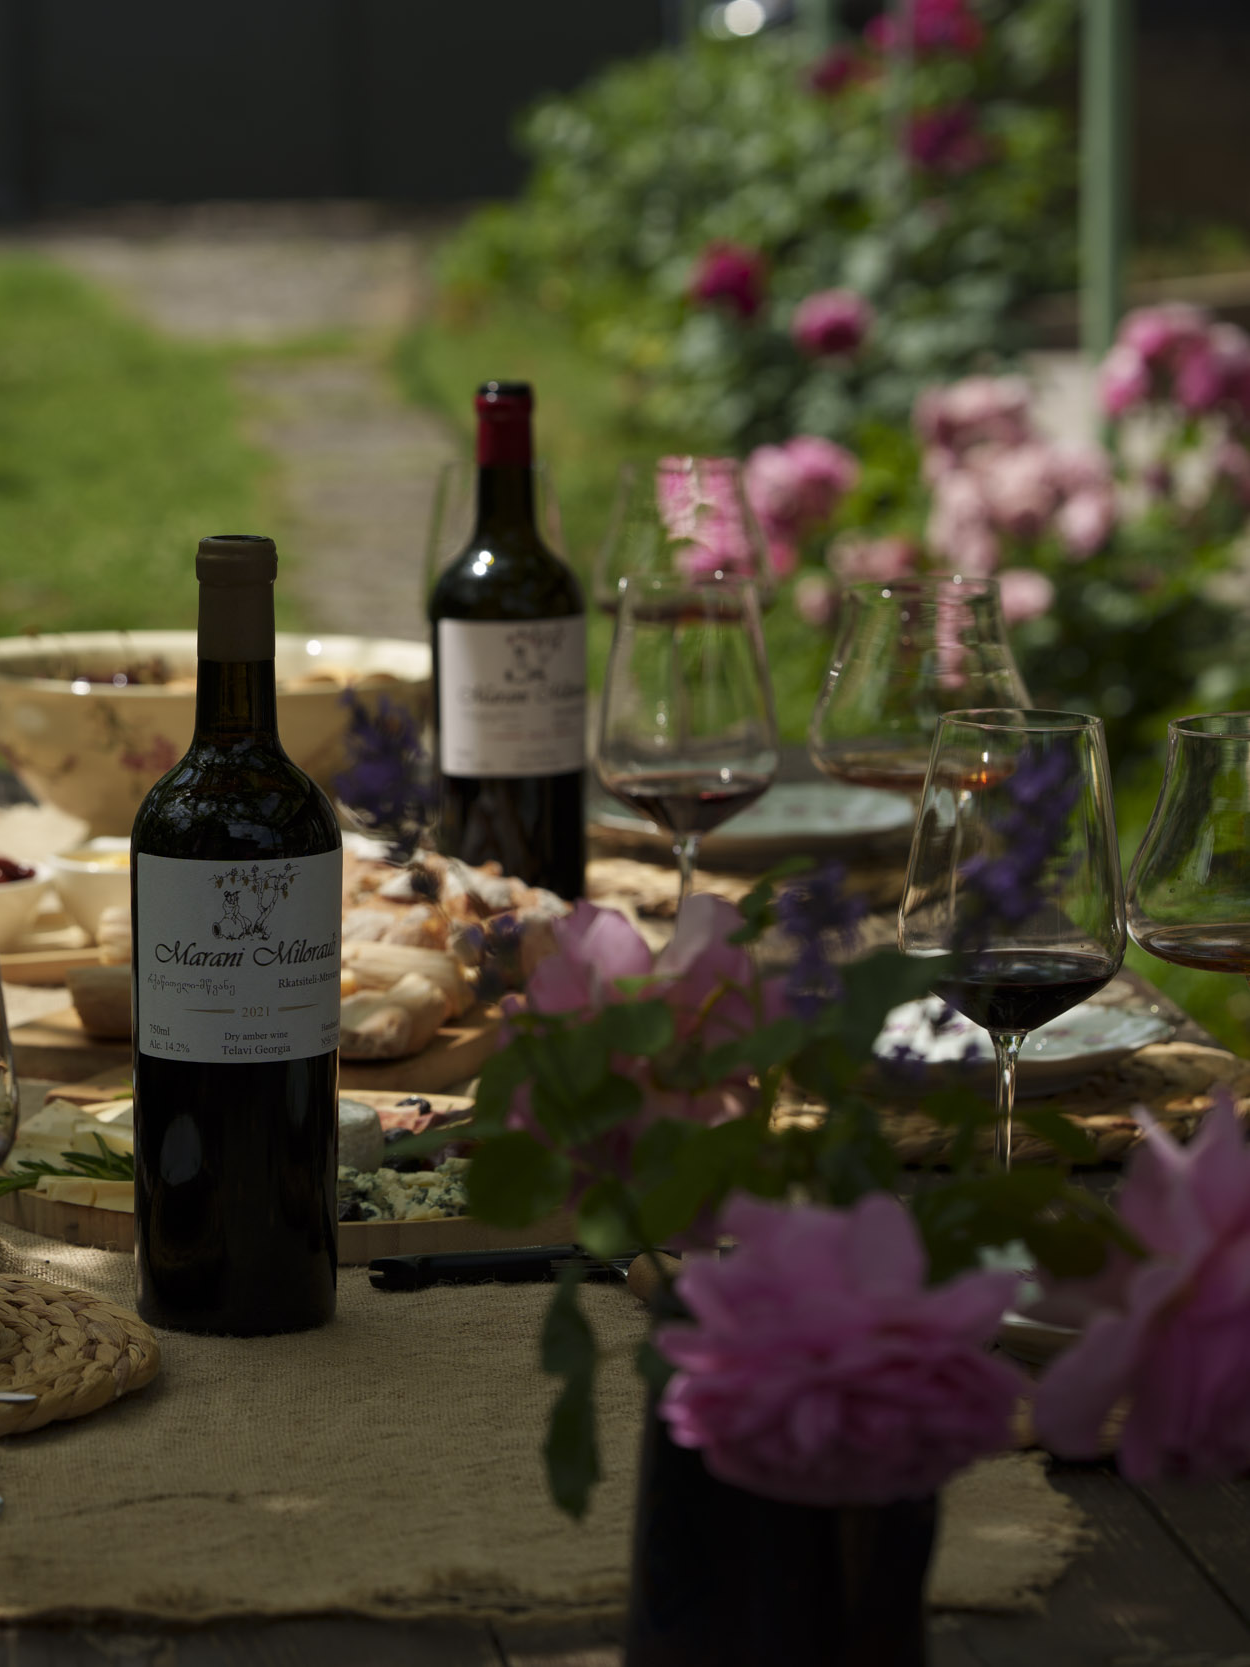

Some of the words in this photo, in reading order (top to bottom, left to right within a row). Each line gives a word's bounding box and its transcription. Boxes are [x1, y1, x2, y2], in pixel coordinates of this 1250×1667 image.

[155, 940, 246, 967] Marani
[242, 1006, 270, 1018] 2021
[149, 1023, 170, 1036] 750ml
[224, 1032, 241, 1043] Dry
[242, 1031, 268, 1041] amber
[270, 1030, 288, 1039] wine
[149, 1039, 163, 1050] Alc.
[165, 1041, 190, 1053] 14.2%
[221, 1045, 252, 1055] Telavi
[254, 1043, 291, 1056] Georgia
